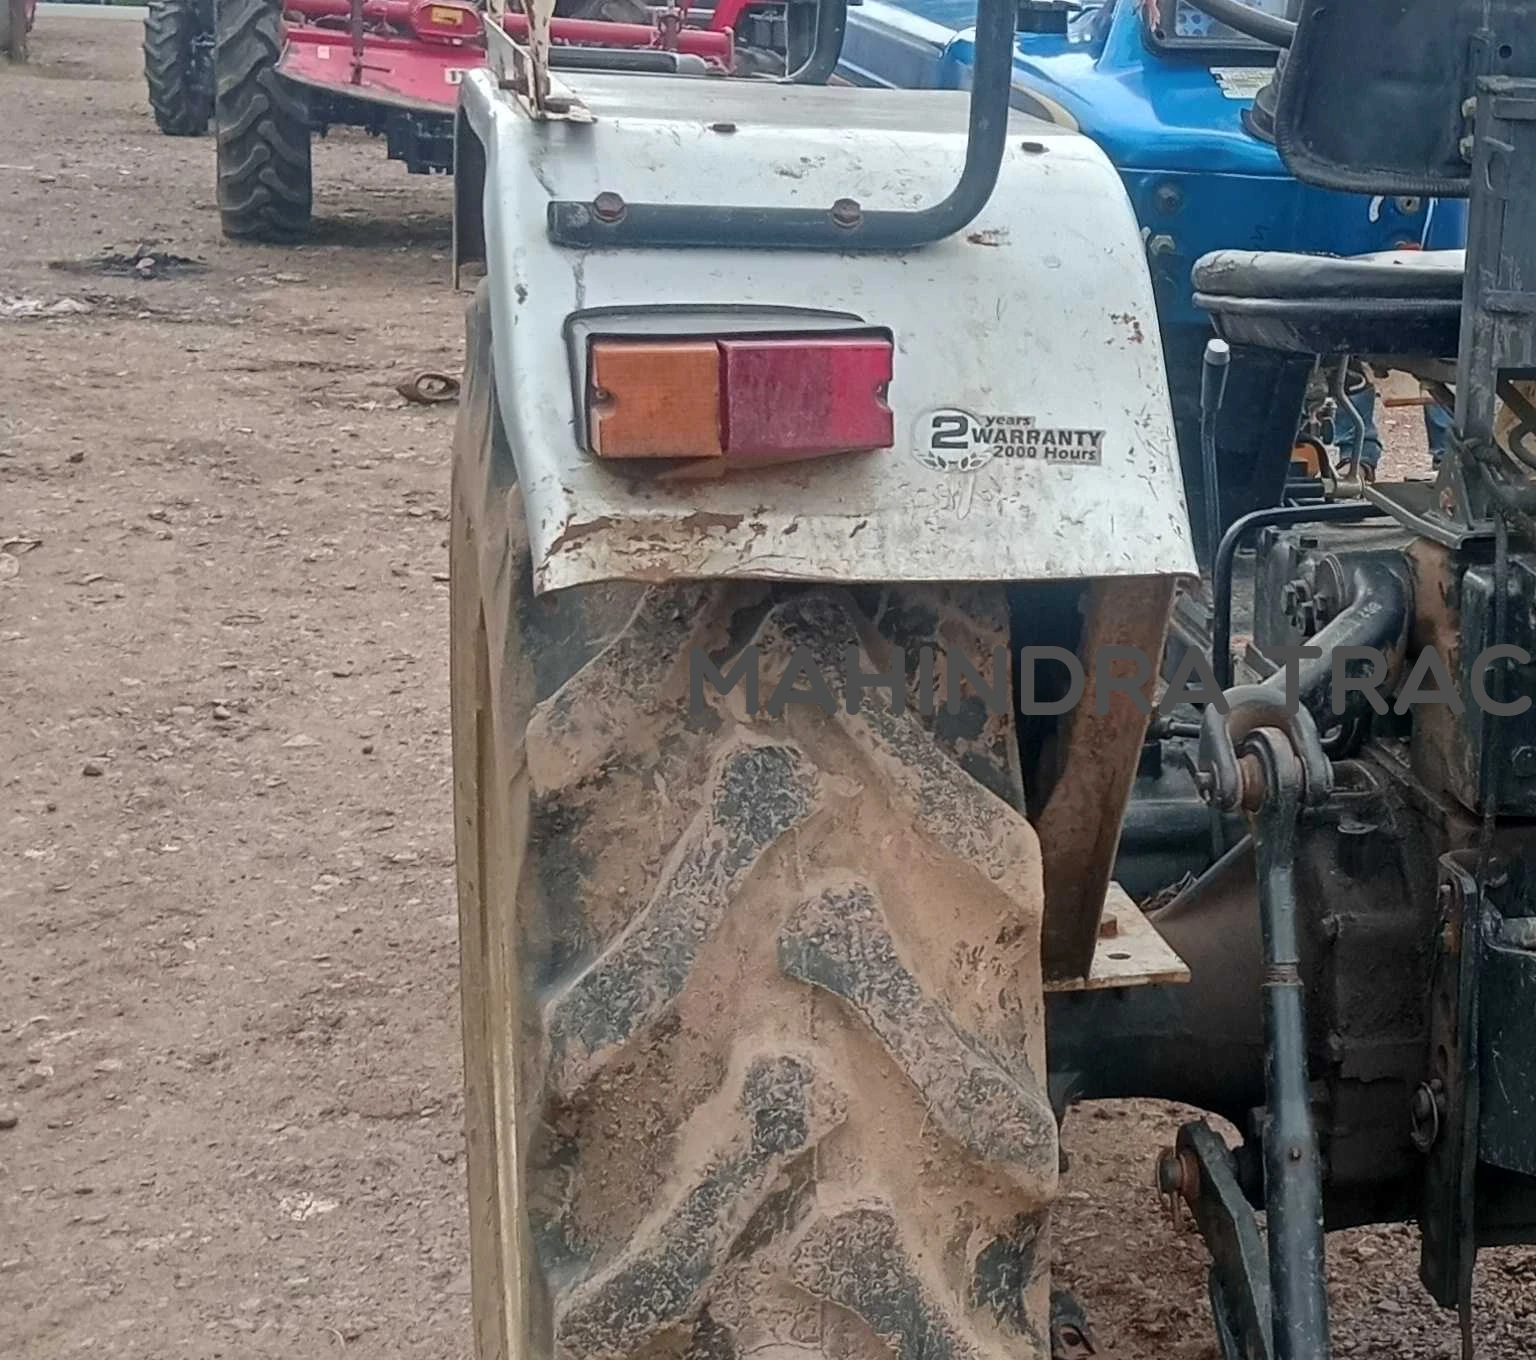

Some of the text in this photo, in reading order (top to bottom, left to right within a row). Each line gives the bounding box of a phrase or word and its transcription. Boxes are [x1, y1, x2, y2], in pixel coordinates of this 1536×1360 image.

[931, 415, 1031, 449] 2 years
[972, 428, 1103, 446] WARRANTY
[993, 445, 1096, 460] 2000 Hours
